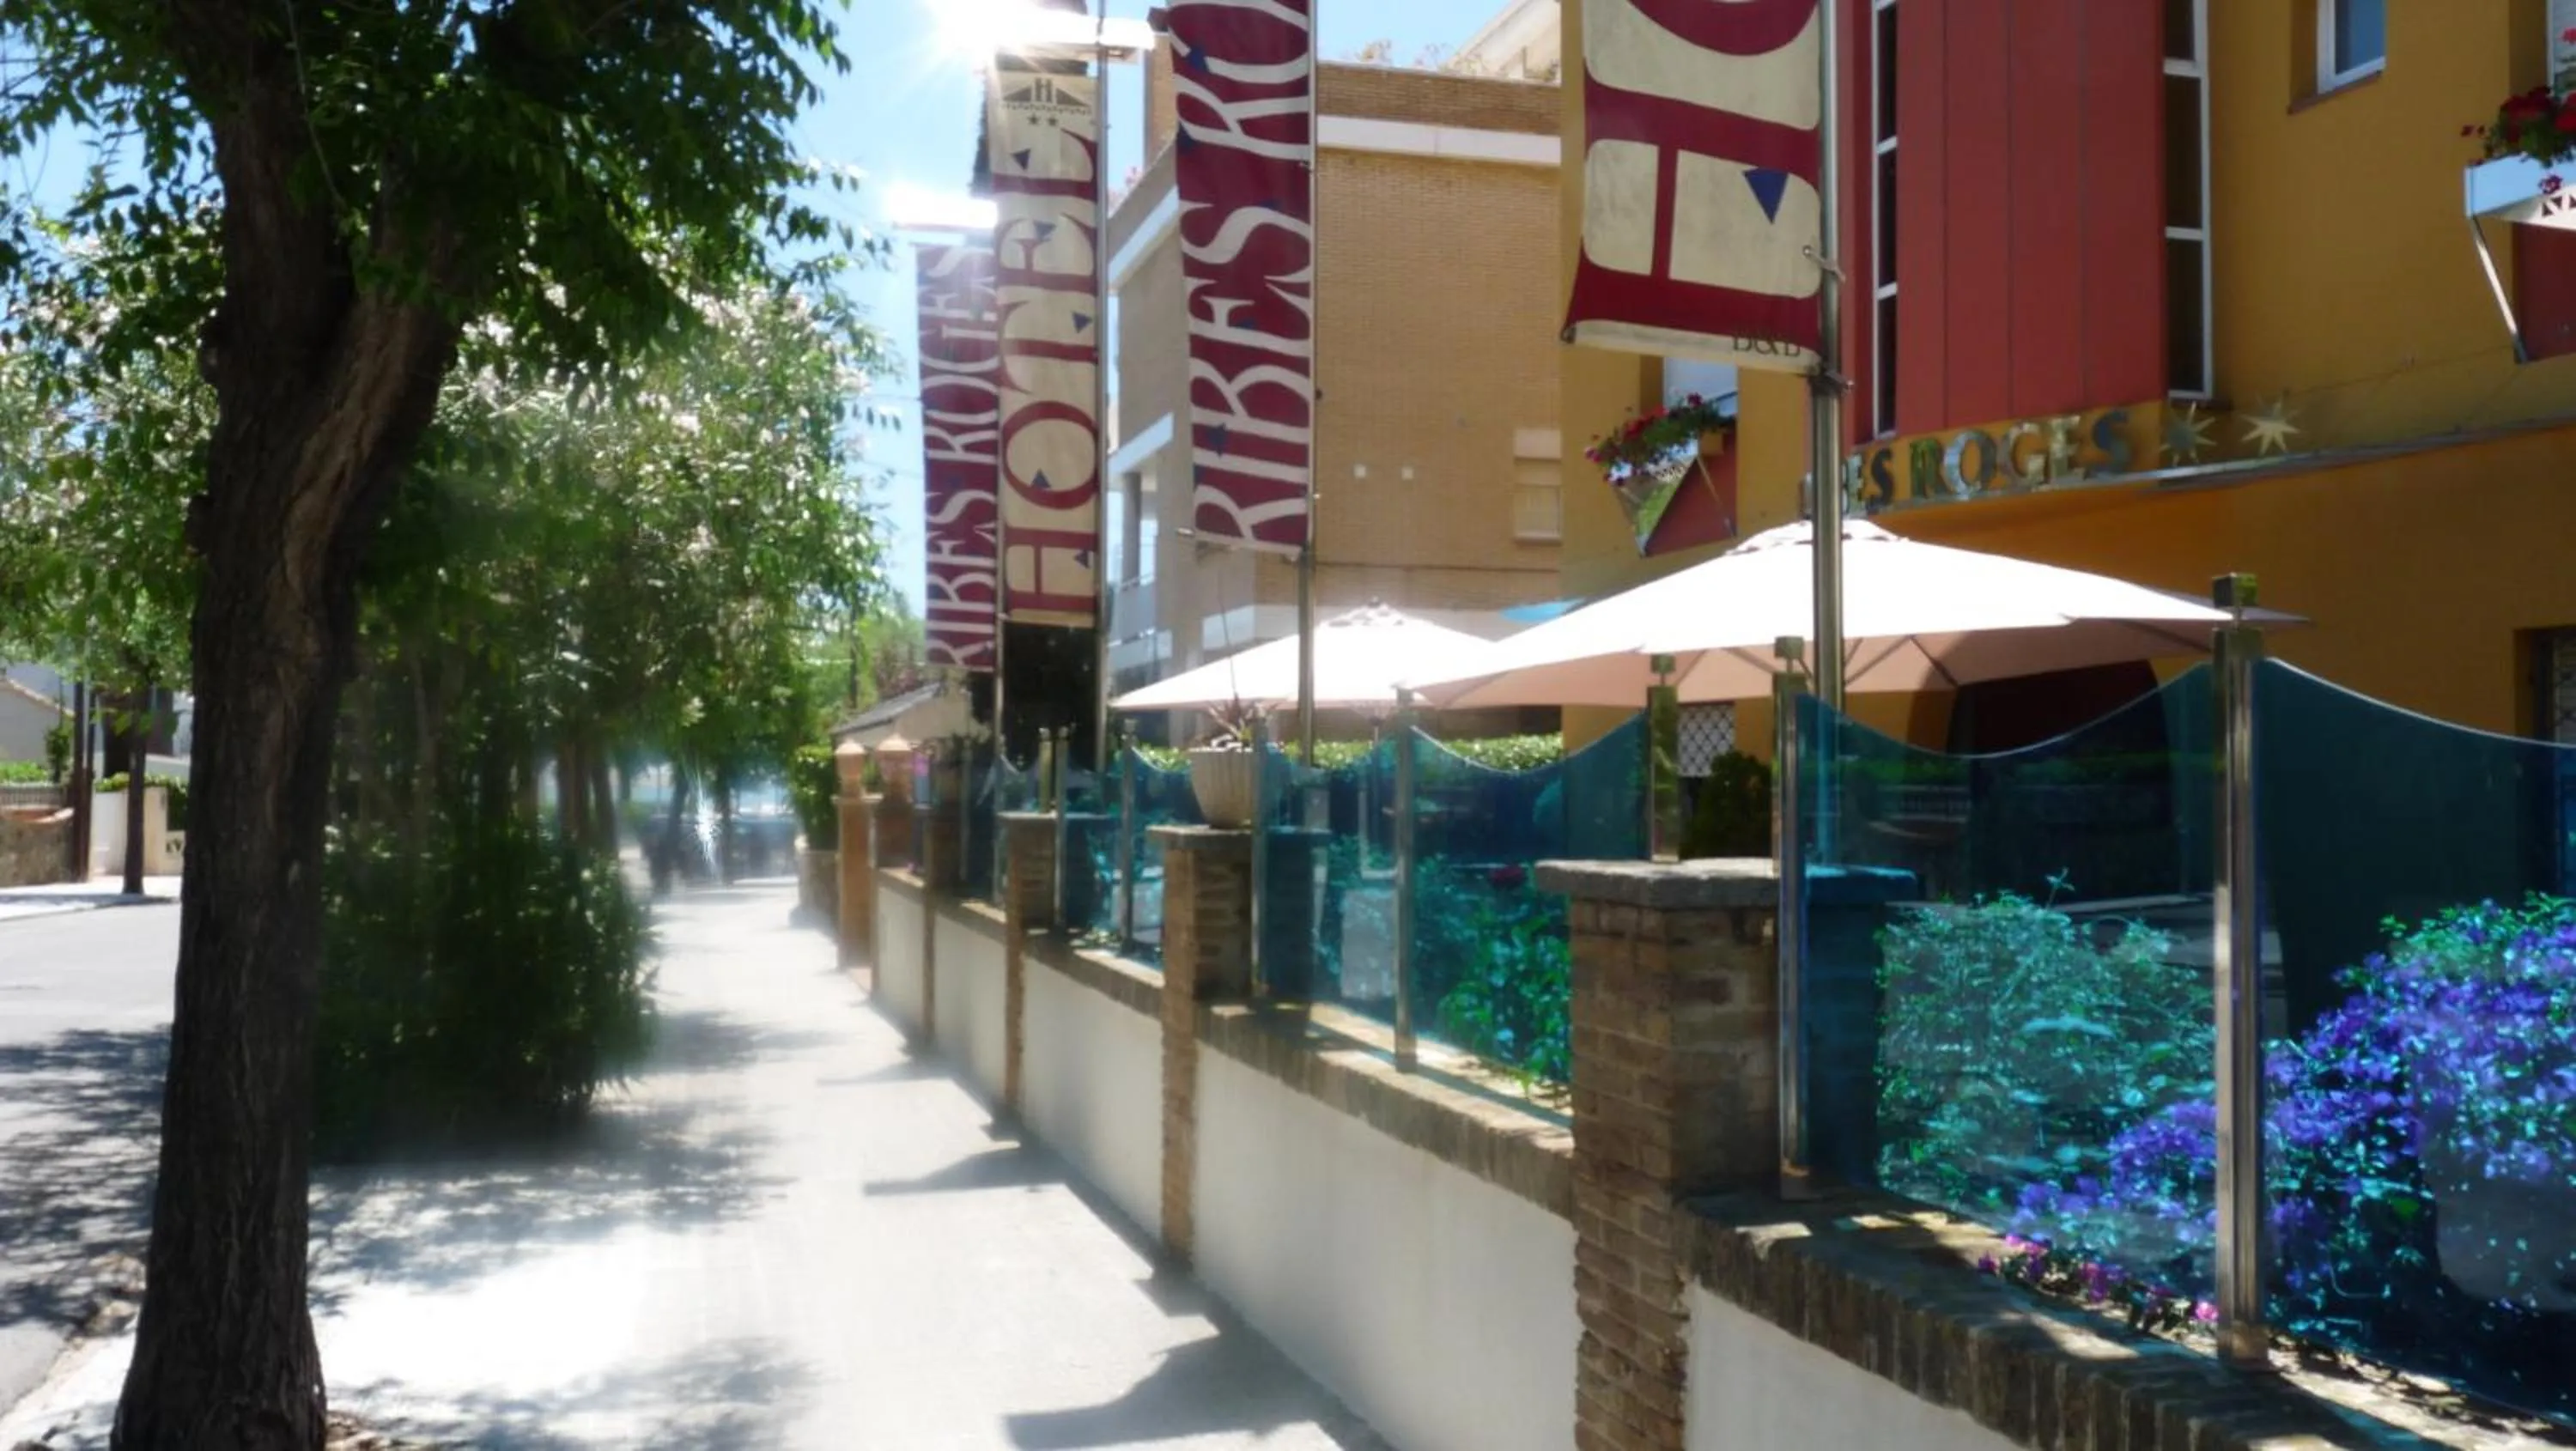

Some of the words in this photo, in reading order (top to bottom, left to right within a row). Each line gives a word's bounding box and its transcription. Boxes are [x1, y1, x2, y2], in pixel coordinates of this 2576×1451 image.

[916, 244, 999, 465] ROGES
[992, 127, 1100, 618] HOTEL
[1179, 200, 1312, 551] RIBES
[1909, 410, 2130, 501] ROGES
[925, 488, 997, 671] RIBES
